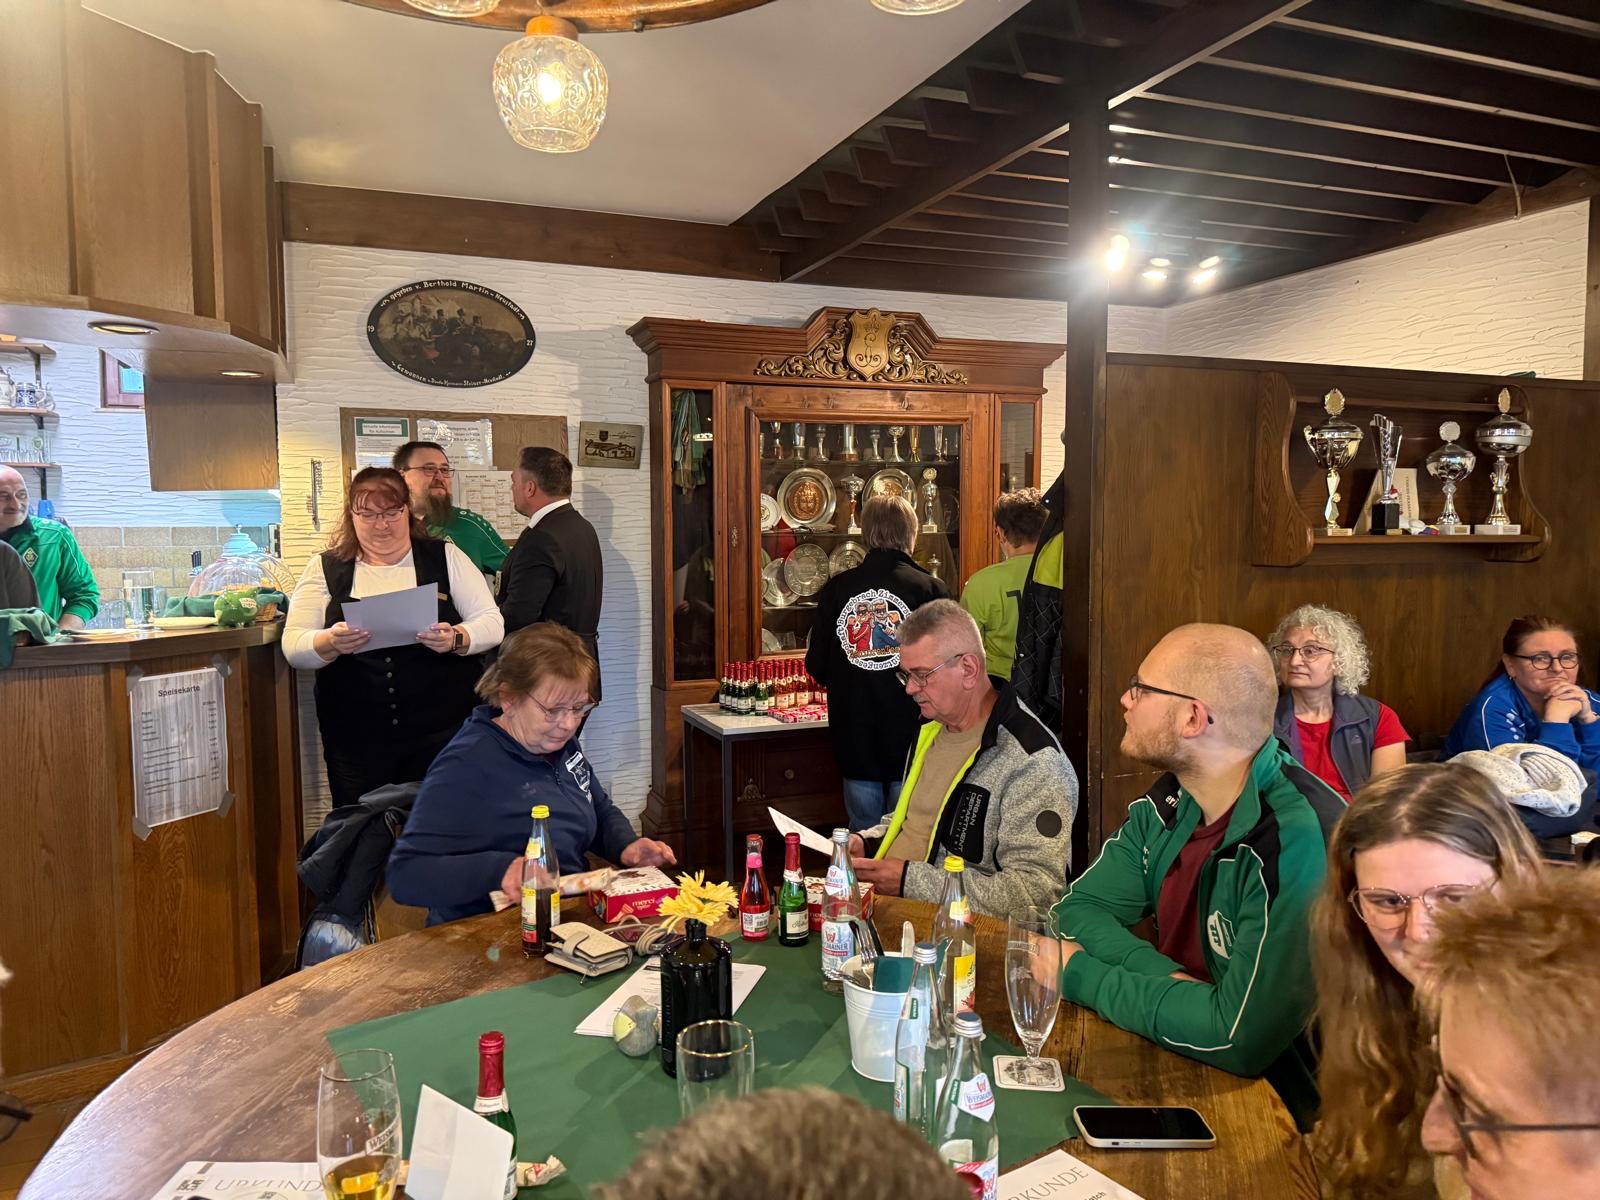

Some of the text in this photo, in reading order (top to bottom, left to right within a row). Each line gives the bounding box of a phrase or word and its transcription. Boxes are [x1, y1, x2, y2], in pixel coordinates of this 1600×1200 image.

[423, 280, 457, 288] Berthold
[461, 282, 489, 295] Martin
[838, 590, 877, 626] Burgebrach
[158, 685, 200, 698] Speisekarte
[959, 792, 977, 852] DEPARTMENT
[970, 794, 982, 826] URBAN
